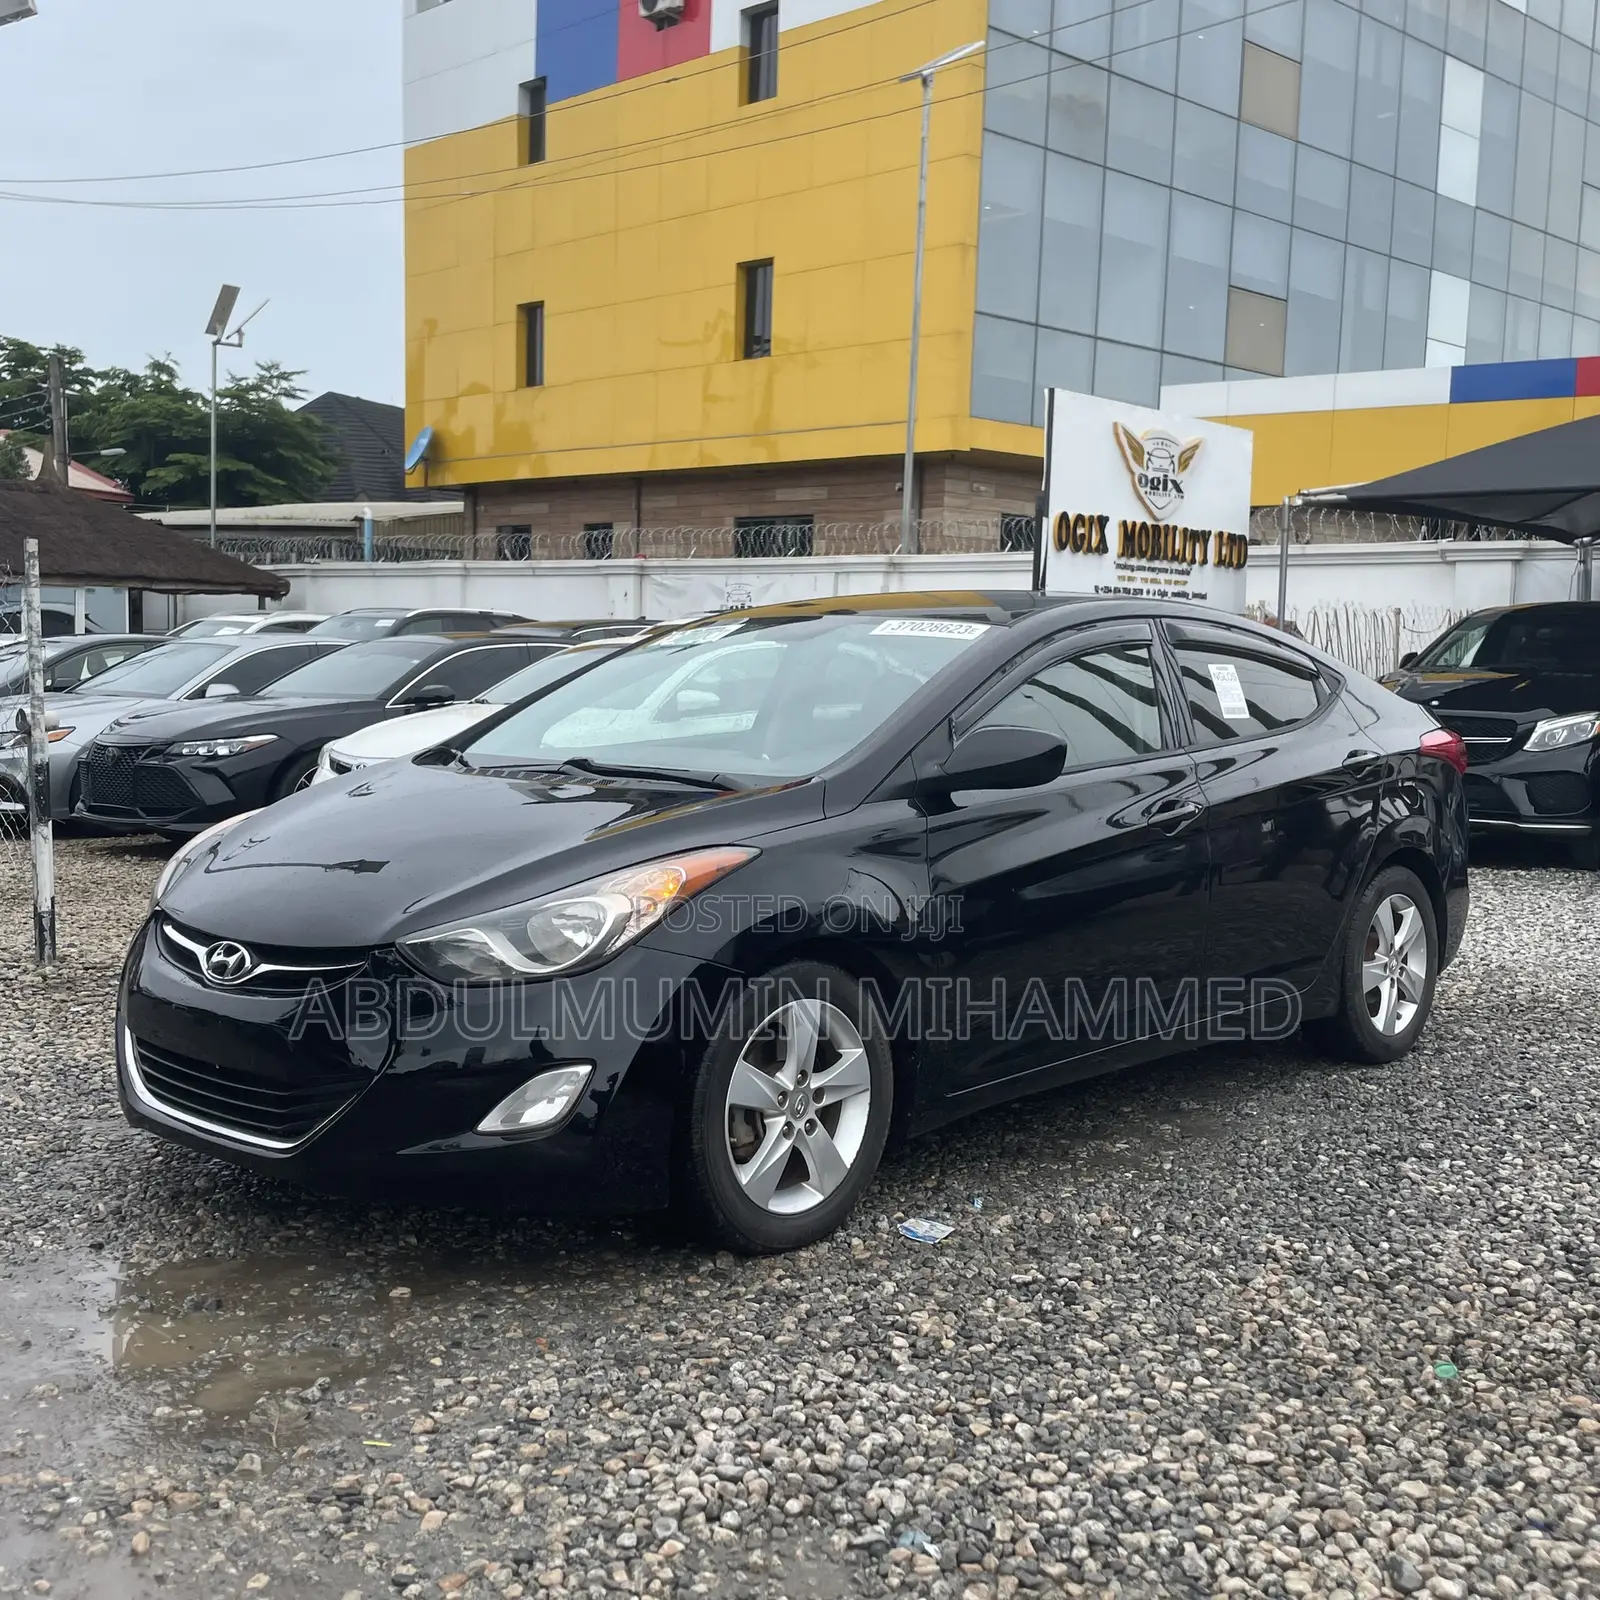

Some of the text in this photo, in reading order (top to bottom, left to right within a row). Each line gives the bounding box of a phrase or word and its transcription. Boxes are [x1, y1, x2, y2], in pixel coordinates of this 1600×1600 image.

[1053, 511, 1248, 569] OGIX MOBILITY LTD
